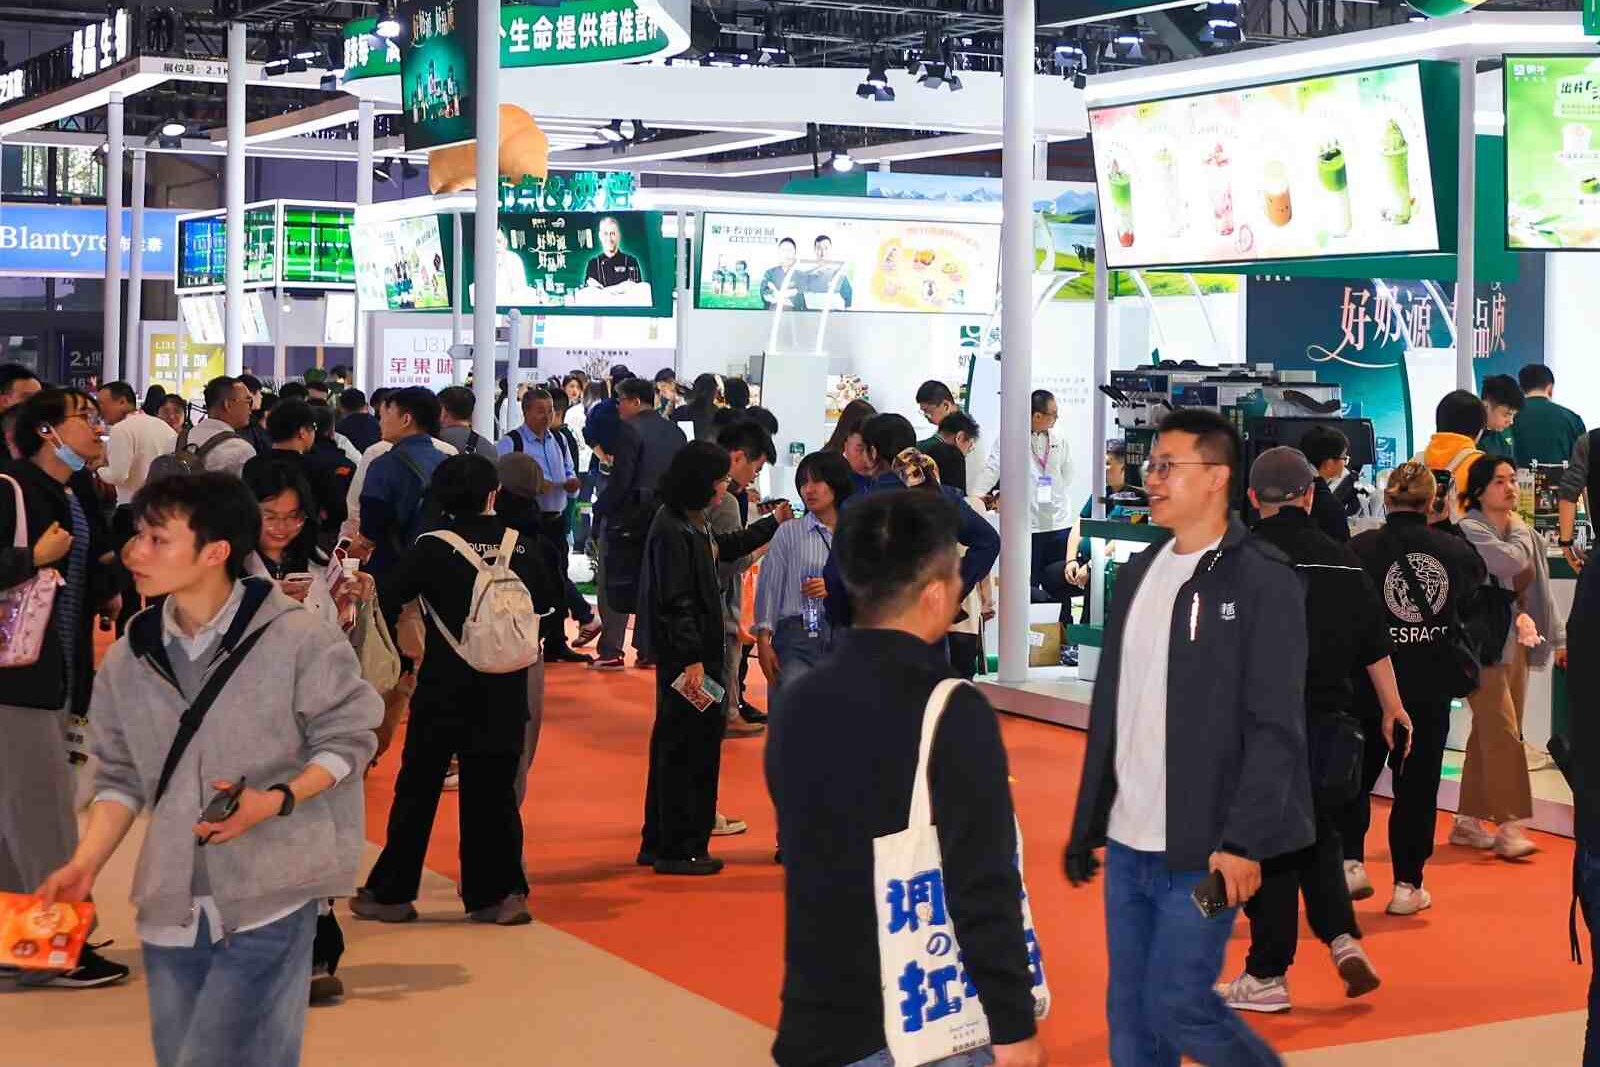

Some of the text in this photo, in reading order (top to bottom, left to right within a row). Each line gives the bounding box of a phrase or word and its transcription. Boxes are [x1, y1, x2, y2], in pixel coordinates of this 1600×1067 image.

[500, 8, 659, 55] 生命提供精准营
[926, 931, 952, 957] の
